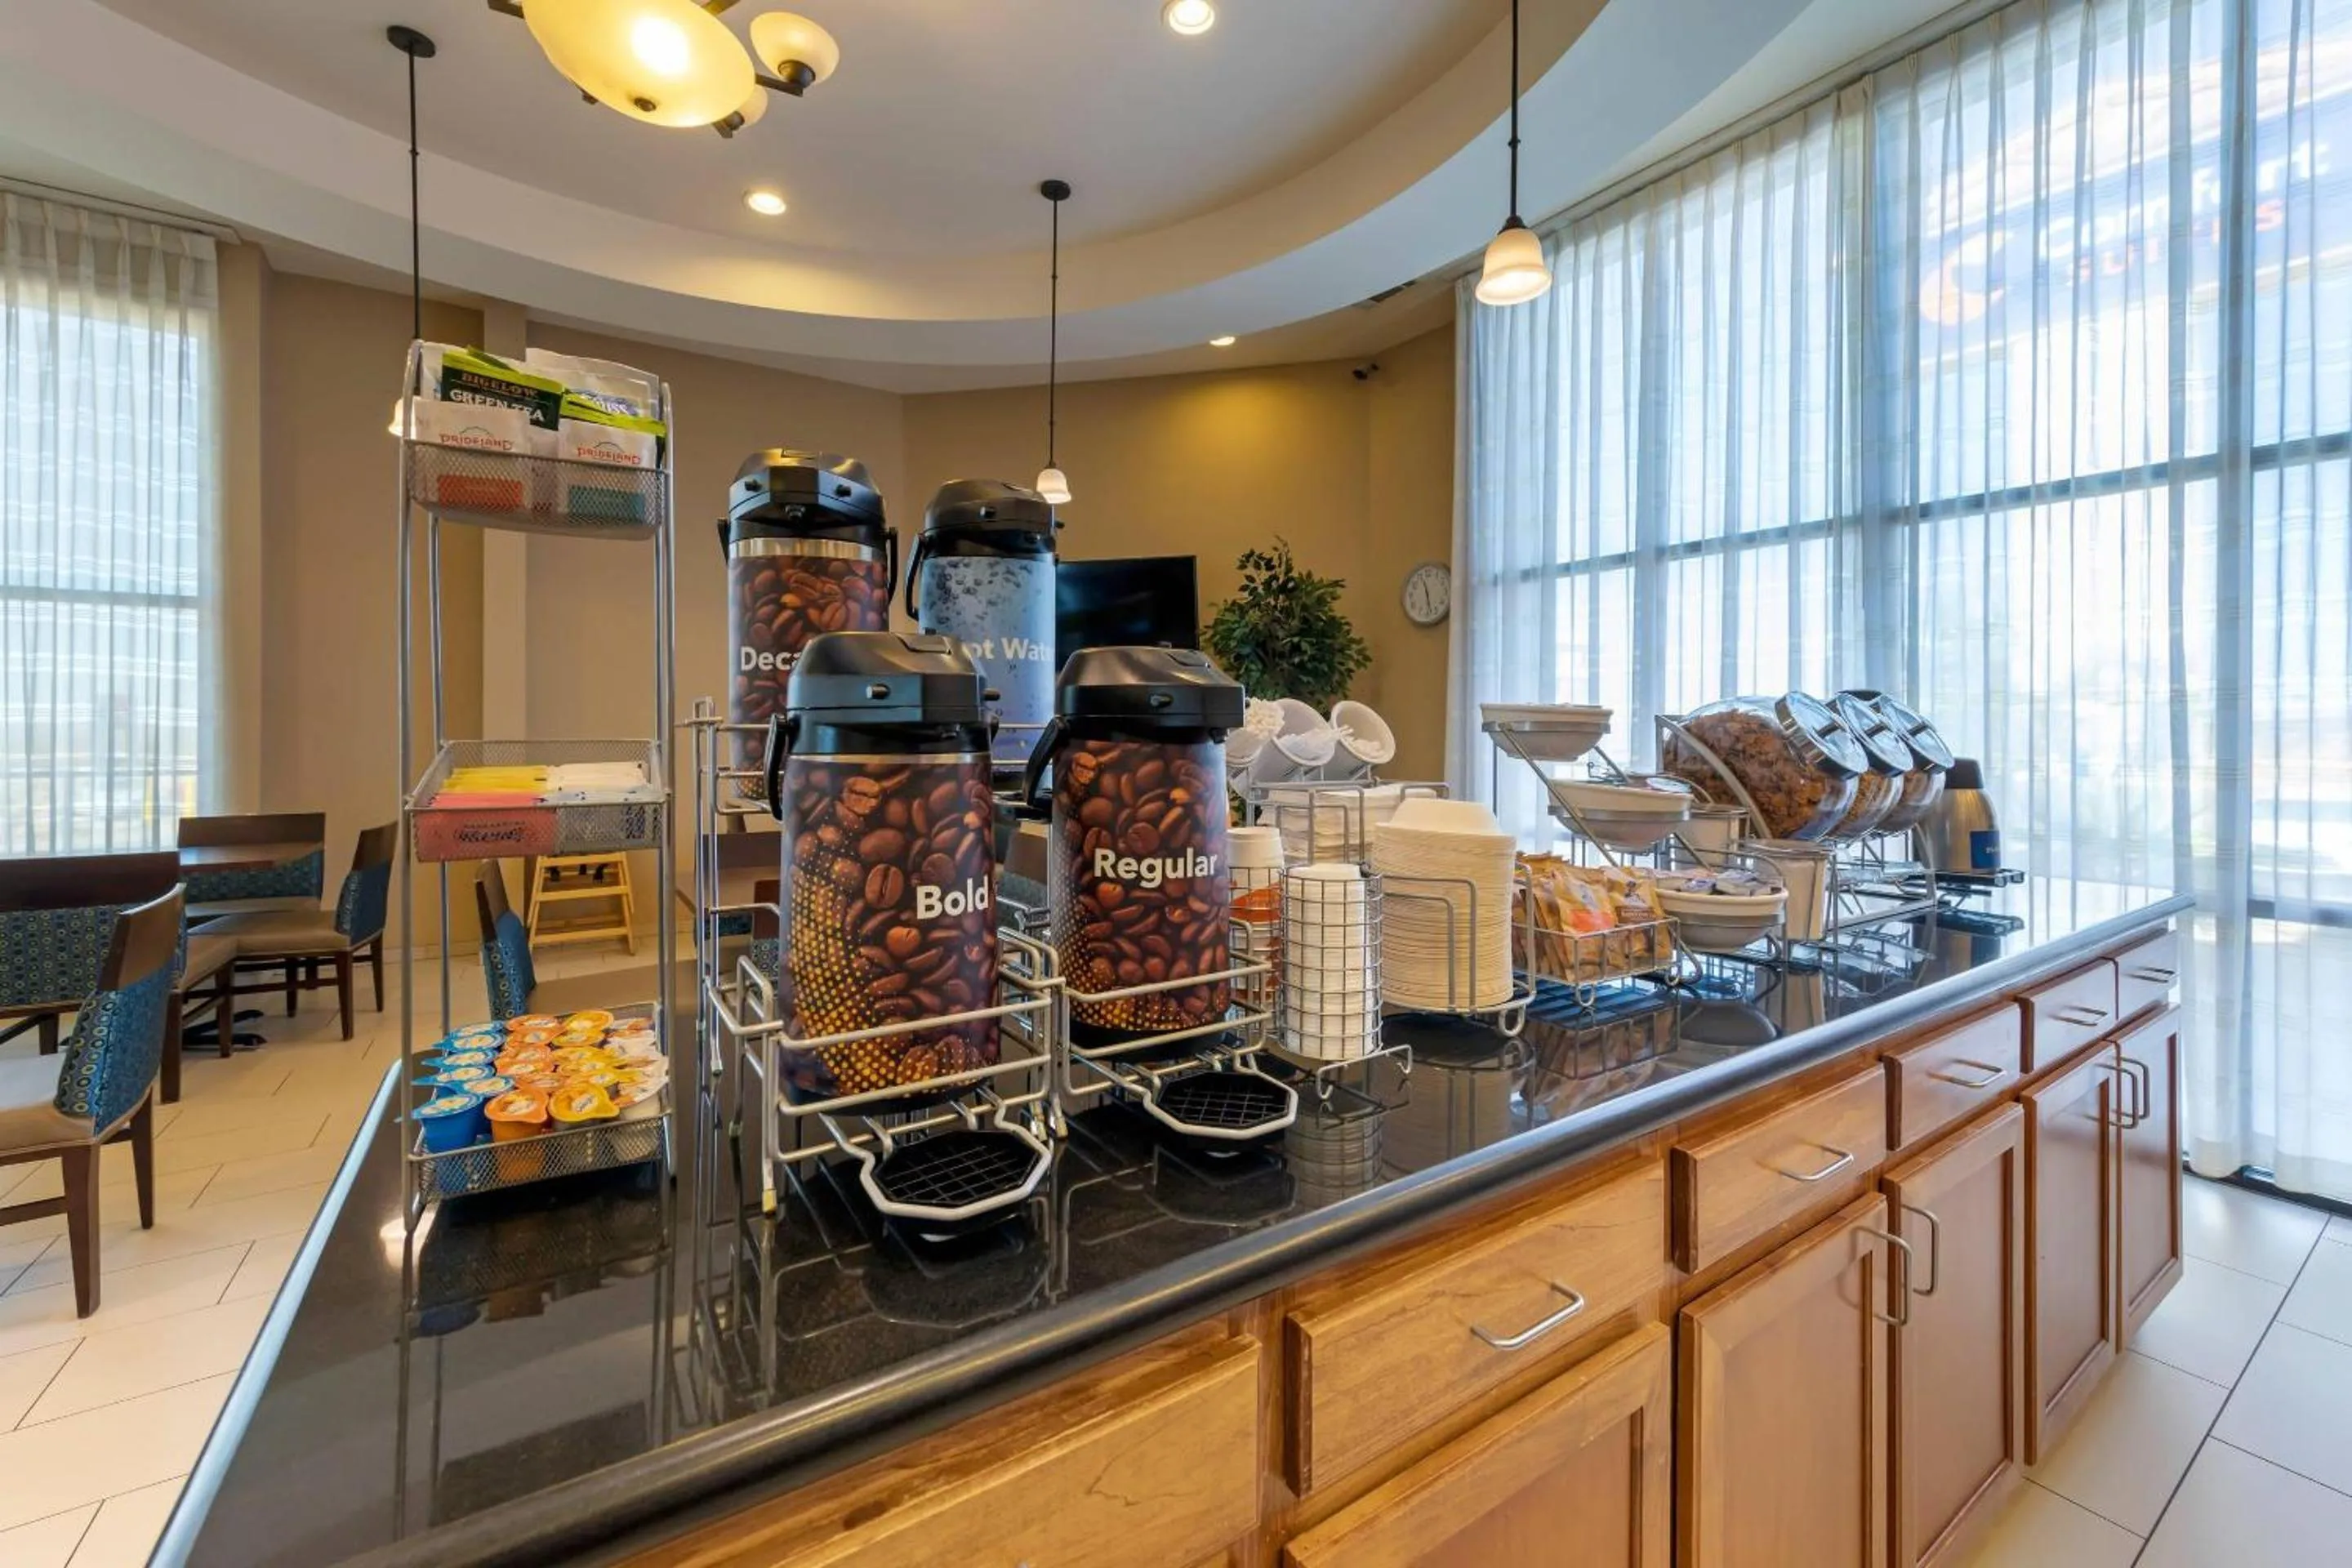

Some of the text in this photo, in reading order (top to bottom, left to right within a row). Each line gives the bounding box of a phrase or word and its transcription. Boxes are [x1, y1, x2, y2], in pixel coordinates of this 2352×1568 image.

[450, 389, 508, 409] GREEN
[1094, 846, 1218, 889] Regular
[916, 875, 989, 920] Bold
